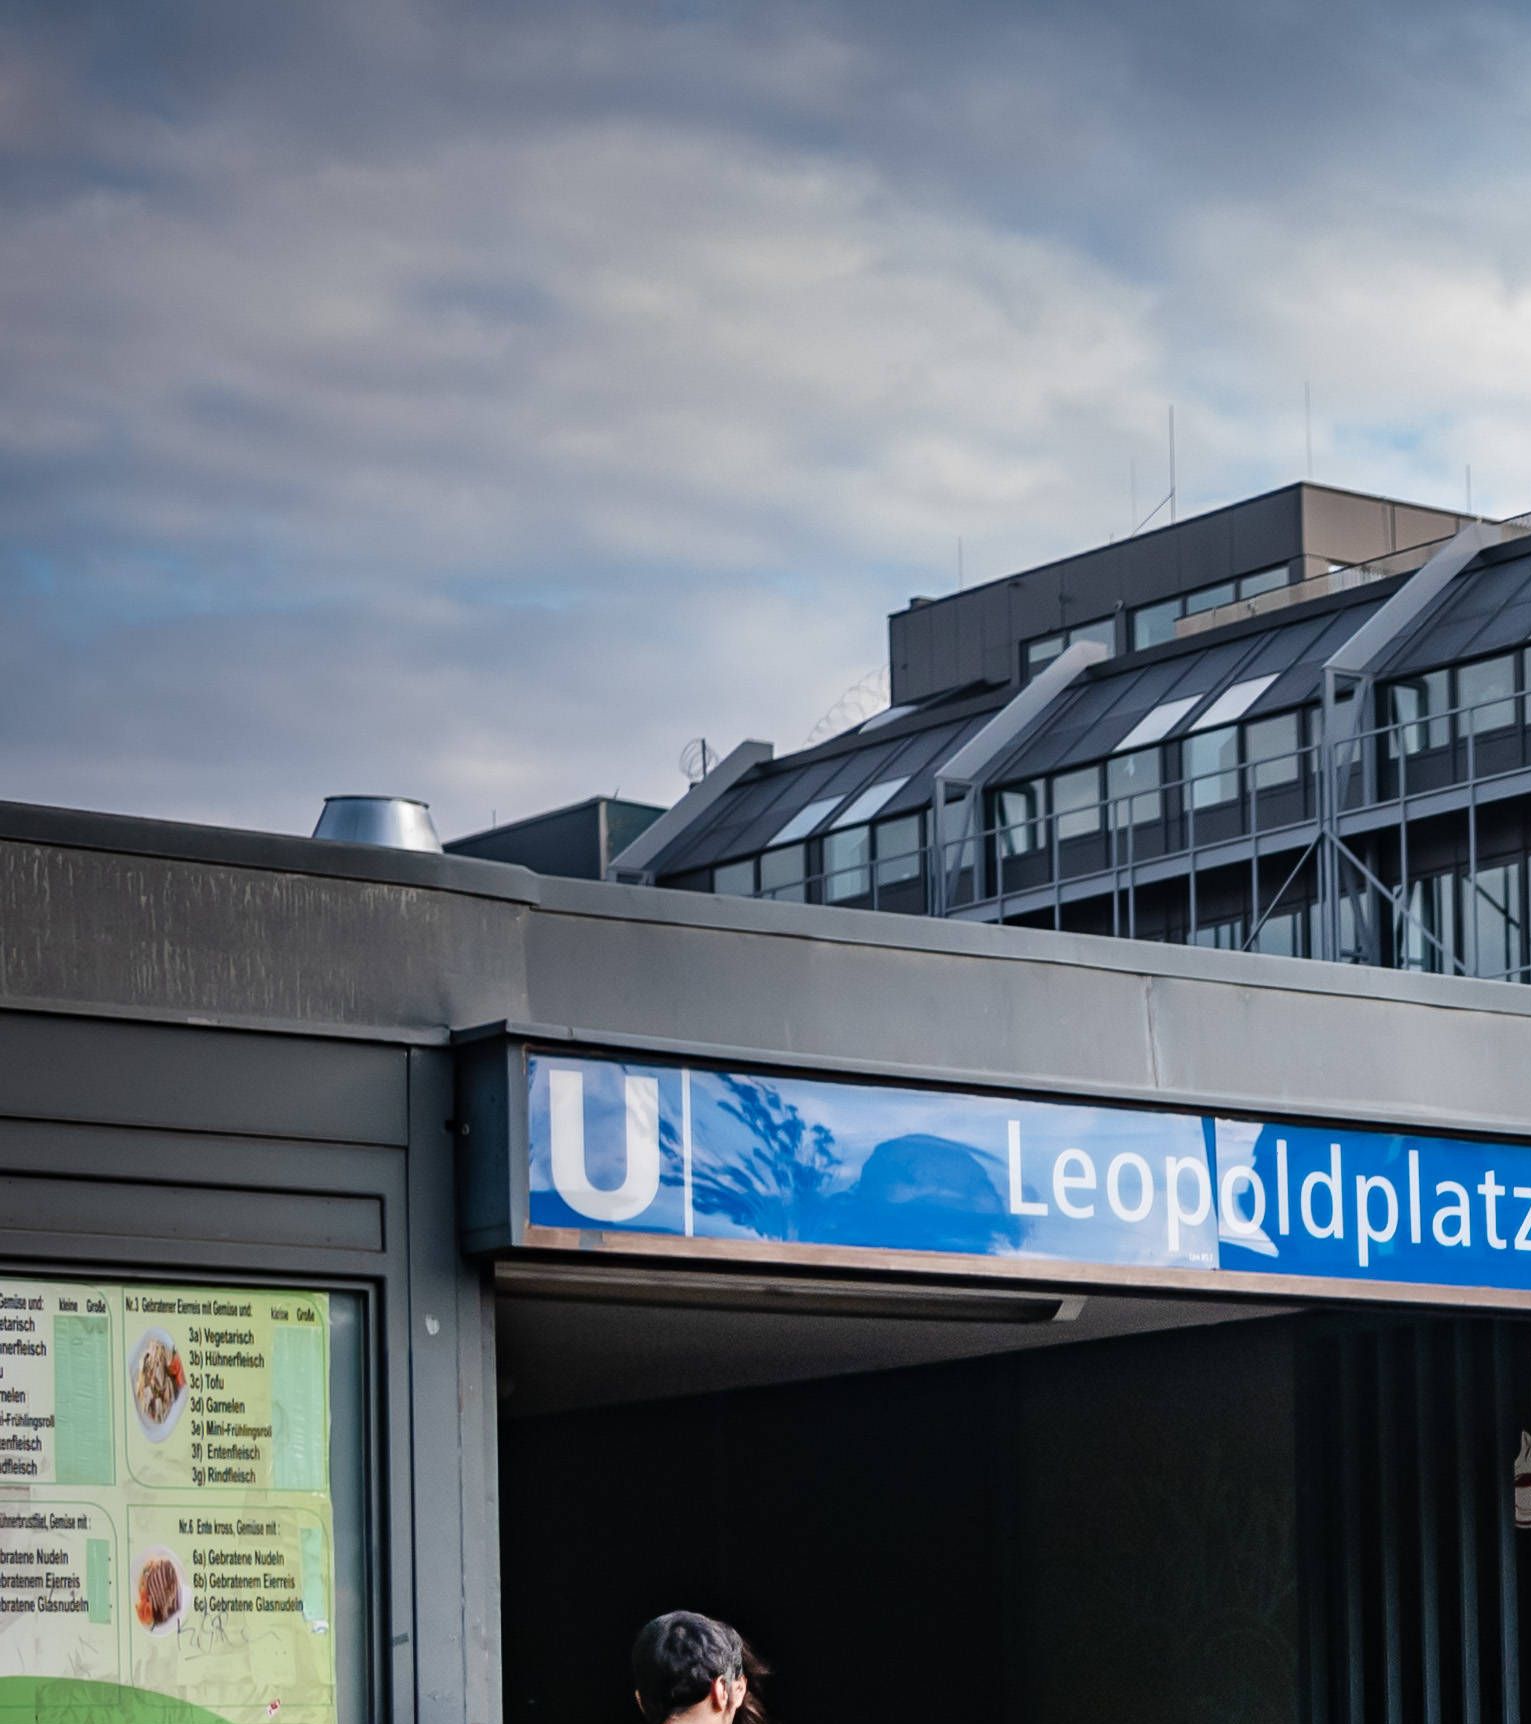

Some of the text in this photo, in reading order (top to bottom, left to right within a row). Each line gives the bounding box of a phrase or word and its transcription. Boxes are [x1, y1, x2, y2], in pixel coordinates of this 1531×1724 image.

[549, 1069, 660, 1222] U
[213, 1300, 238, 1316] Gemüse
[189, 1327, 254, 1348] 3a) Vegetarisch
[189, 1351, 264, 1370] 3b) Hühnerfleisch
[190, 1374, 224, 1393] 3c) Tofu
[206, 1397, 245, 1414] Garnelen
[208, 1444, 260, 1461] Entenfleisch
[208, 1467, 256, 1483] Rindfleisch
[236, 1519, 264, 1535] Gemüse
[36, 1548, 69, 1564] Nudeln
[208, 1549, 252, 1566] Gebratene
[254, 1550, 284, 1566] Nudeln
[46, 1572, 80, 1589] Eierreis
[209, 1573, 261, 1589] Gebratenem
[264, 1573, 295, 1589] Eierreis
[37, 1596, 89, 1613] Glasnudeln
[209, 1596, 253, 1612] Gebratene
[256, 1596, 303, 1613] Glasnudeln
